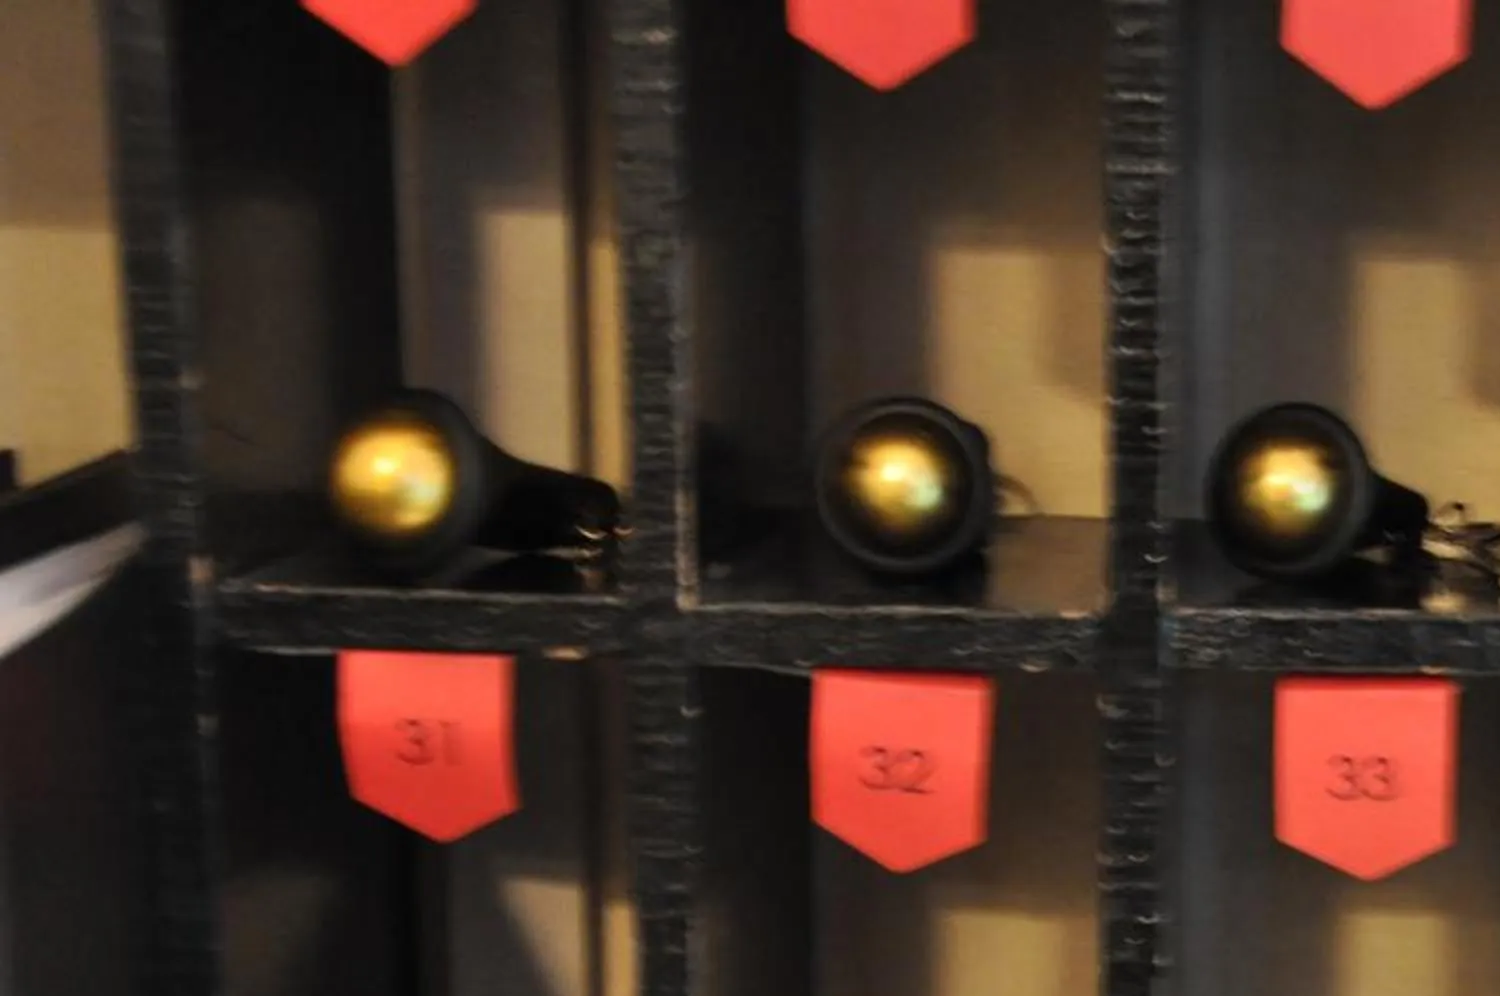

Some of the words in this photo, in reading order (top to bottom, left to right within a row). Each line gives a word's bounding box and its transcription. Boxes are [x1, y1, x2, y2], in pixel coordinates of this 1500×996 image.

[394, 717, 463, 767] 31
[857, 745, 938, 795] 32
[1325, 754, 1402, 802] 33
